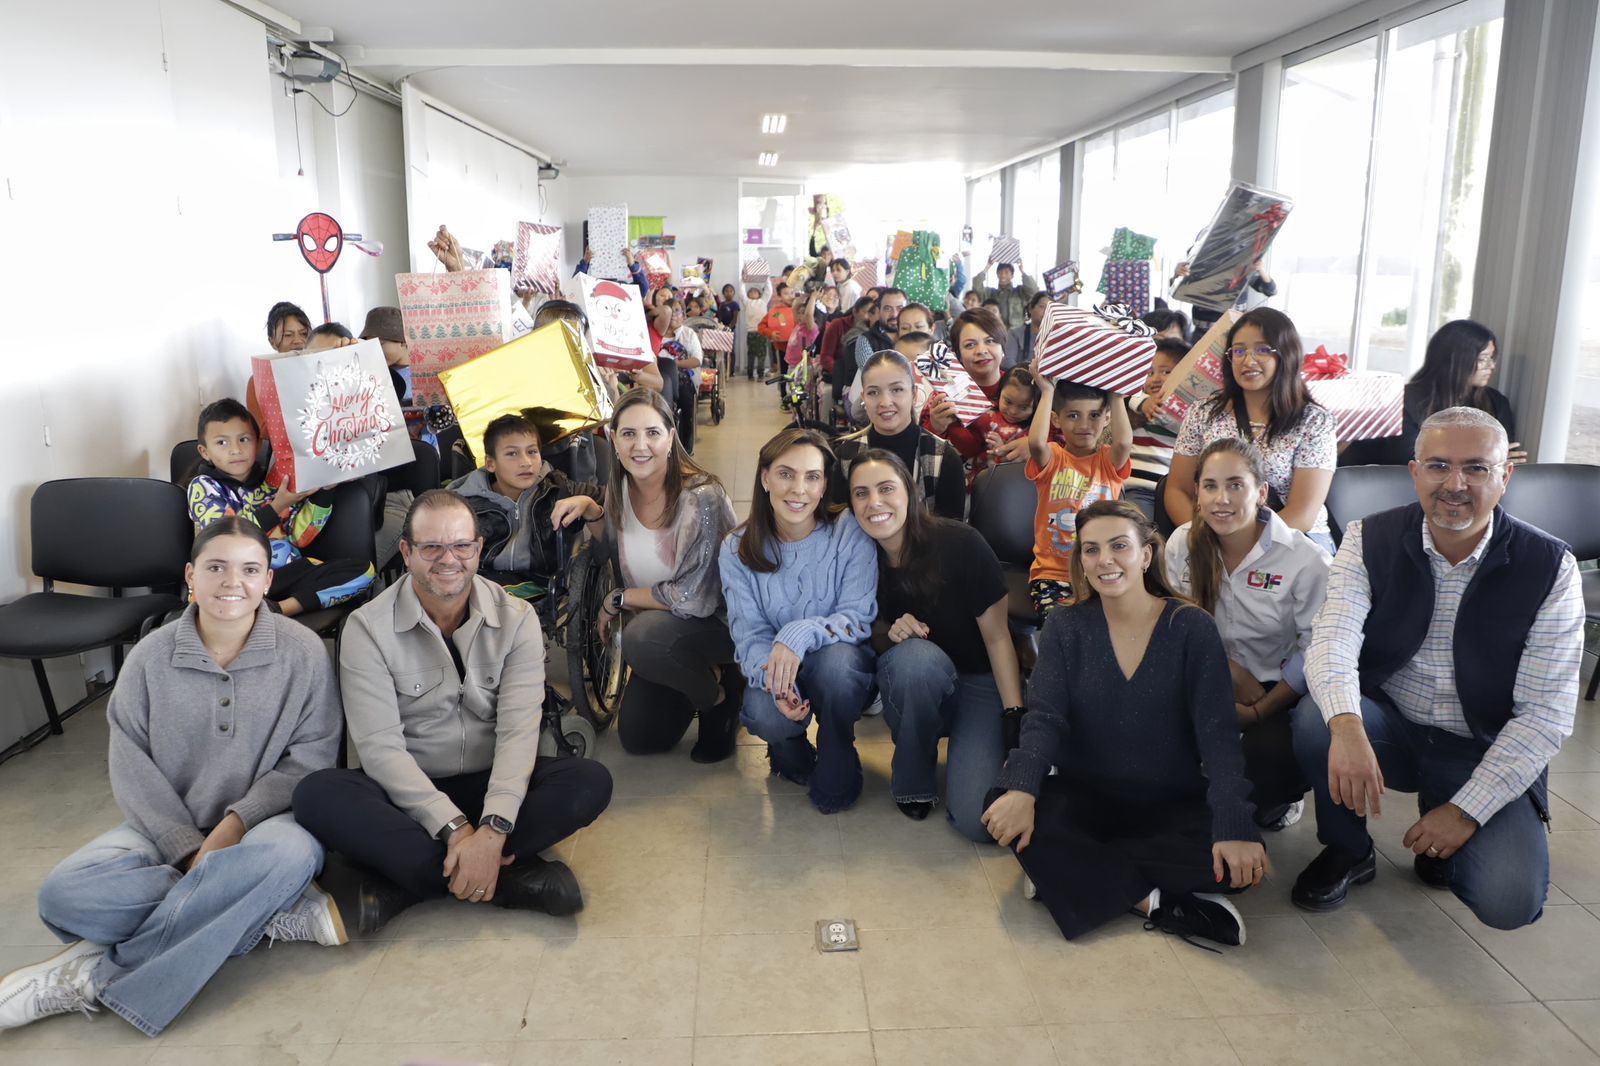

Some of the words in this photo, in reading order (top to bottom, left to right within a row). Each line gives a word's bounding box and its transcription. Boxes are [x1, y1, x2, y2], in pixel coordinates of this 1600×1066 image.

[316, 375, 377, 420] Merry
[312, 404, 391, 456] Christmas
[1051, 467, 1089, 491] WAVE
